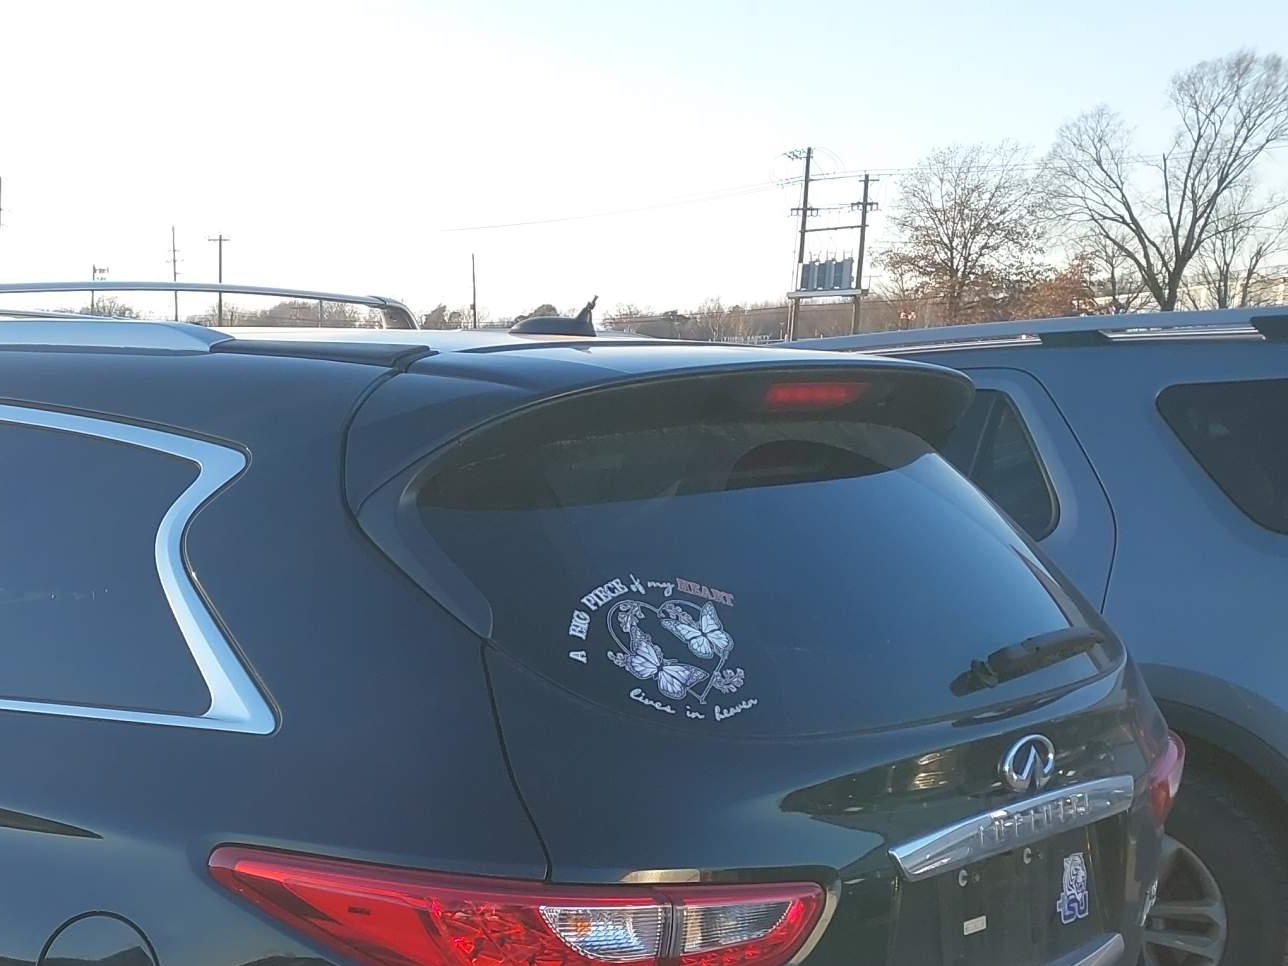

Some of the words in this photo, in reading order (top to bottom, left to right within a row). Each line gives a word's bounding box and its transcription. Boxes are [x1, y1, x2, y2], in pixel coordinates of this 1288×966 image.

[580, 578, 629, 611] PIECE
[630, 573, 646, 595] of
[647, 580, 675, 597] my
[676, 577, 735, 607] HEART
[568, 609, 591, 640] BIG
[569, 650, 588, 664] A
[629, 687, 676, 714] lives
[686, 705, 705, 719] in
[714, 698, 758, 721] heaven
